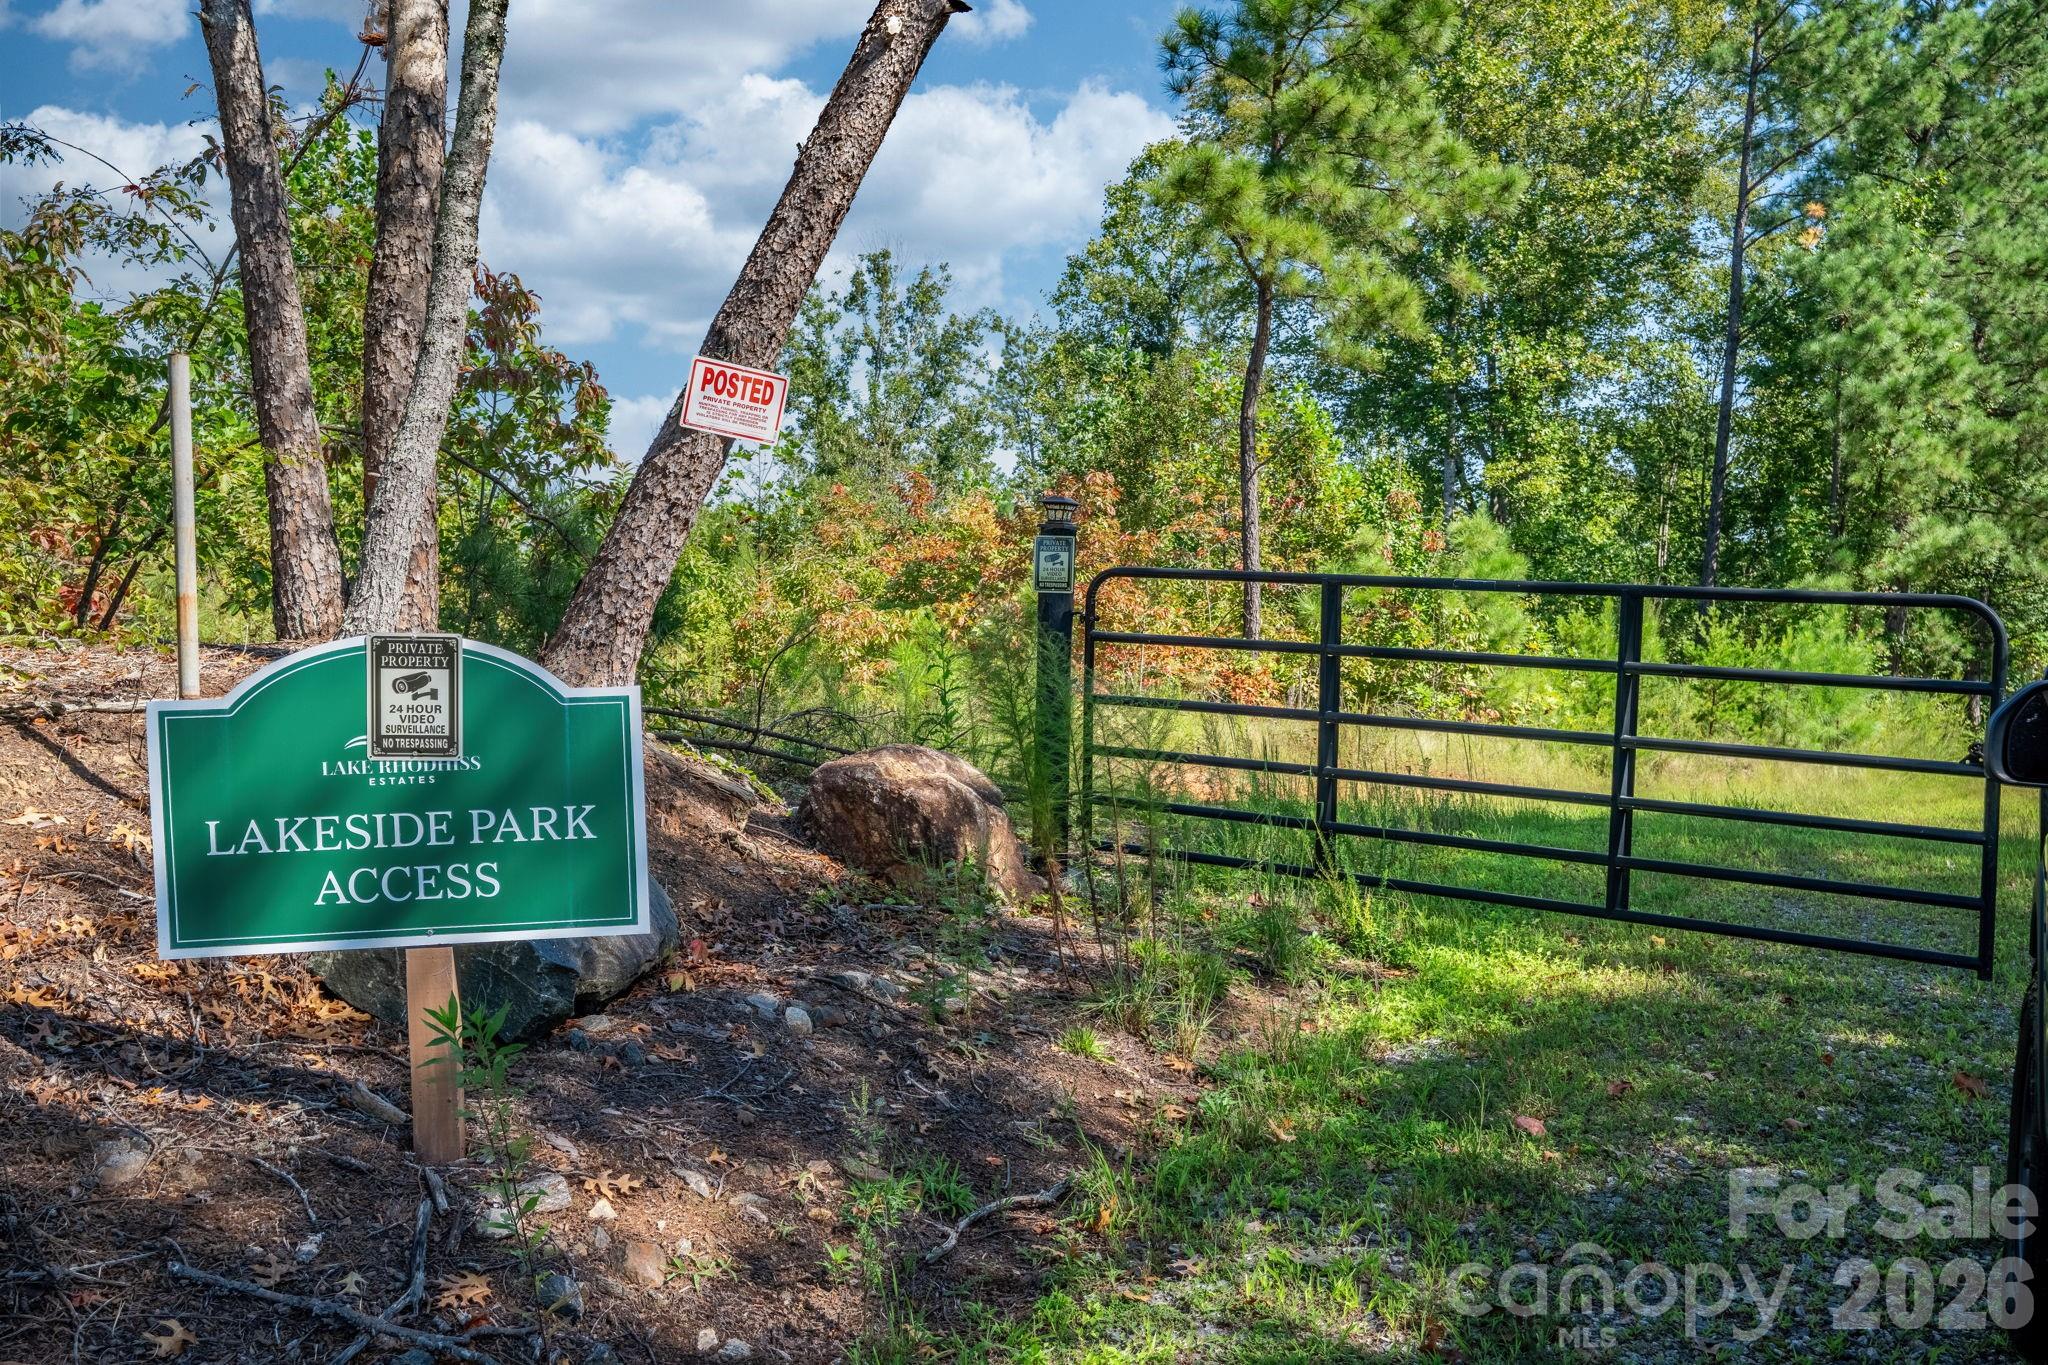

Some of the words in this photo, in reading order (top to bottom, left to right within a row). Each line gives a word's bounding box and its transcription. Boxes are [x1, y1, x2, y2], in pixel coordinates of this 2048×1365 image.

[701, 366, 774, 406] POSTED
[703, 395, 731, 406] PRIVATE
[732, 402, 767, 413] PROPERTY
[700, 406, 728, 414] TRESPASSING
[740, 410, 761, 419] TRAPPING
[696, 412, 720, 420] VIOLATORS
[739, 421, 767, 430] PROSECUTED
[734, 416, 759, 425] FORBIDDEN
[388, 642, 444, 654] PRIVATE
[381, 656, 448, 667] PROPERTY
[389, 704, 403, 713] 24
[406, 704, 442, 714] HOUR
[400, 715, 435, 724] VIDEO
[386, 725, 446, 734] SURVEILLANCE
[382, 738, 394, 748] NO
[396, 738, 448, 748] TRESPASSING
[322, 760, 373, 776] LAKE
[369, 776, 436, 786] ESTATES
[205, 810, 454, 856] LAKESIDE
[468, 804, 598, 844] PARK
[314, 862, 500, 906] ACCESS
